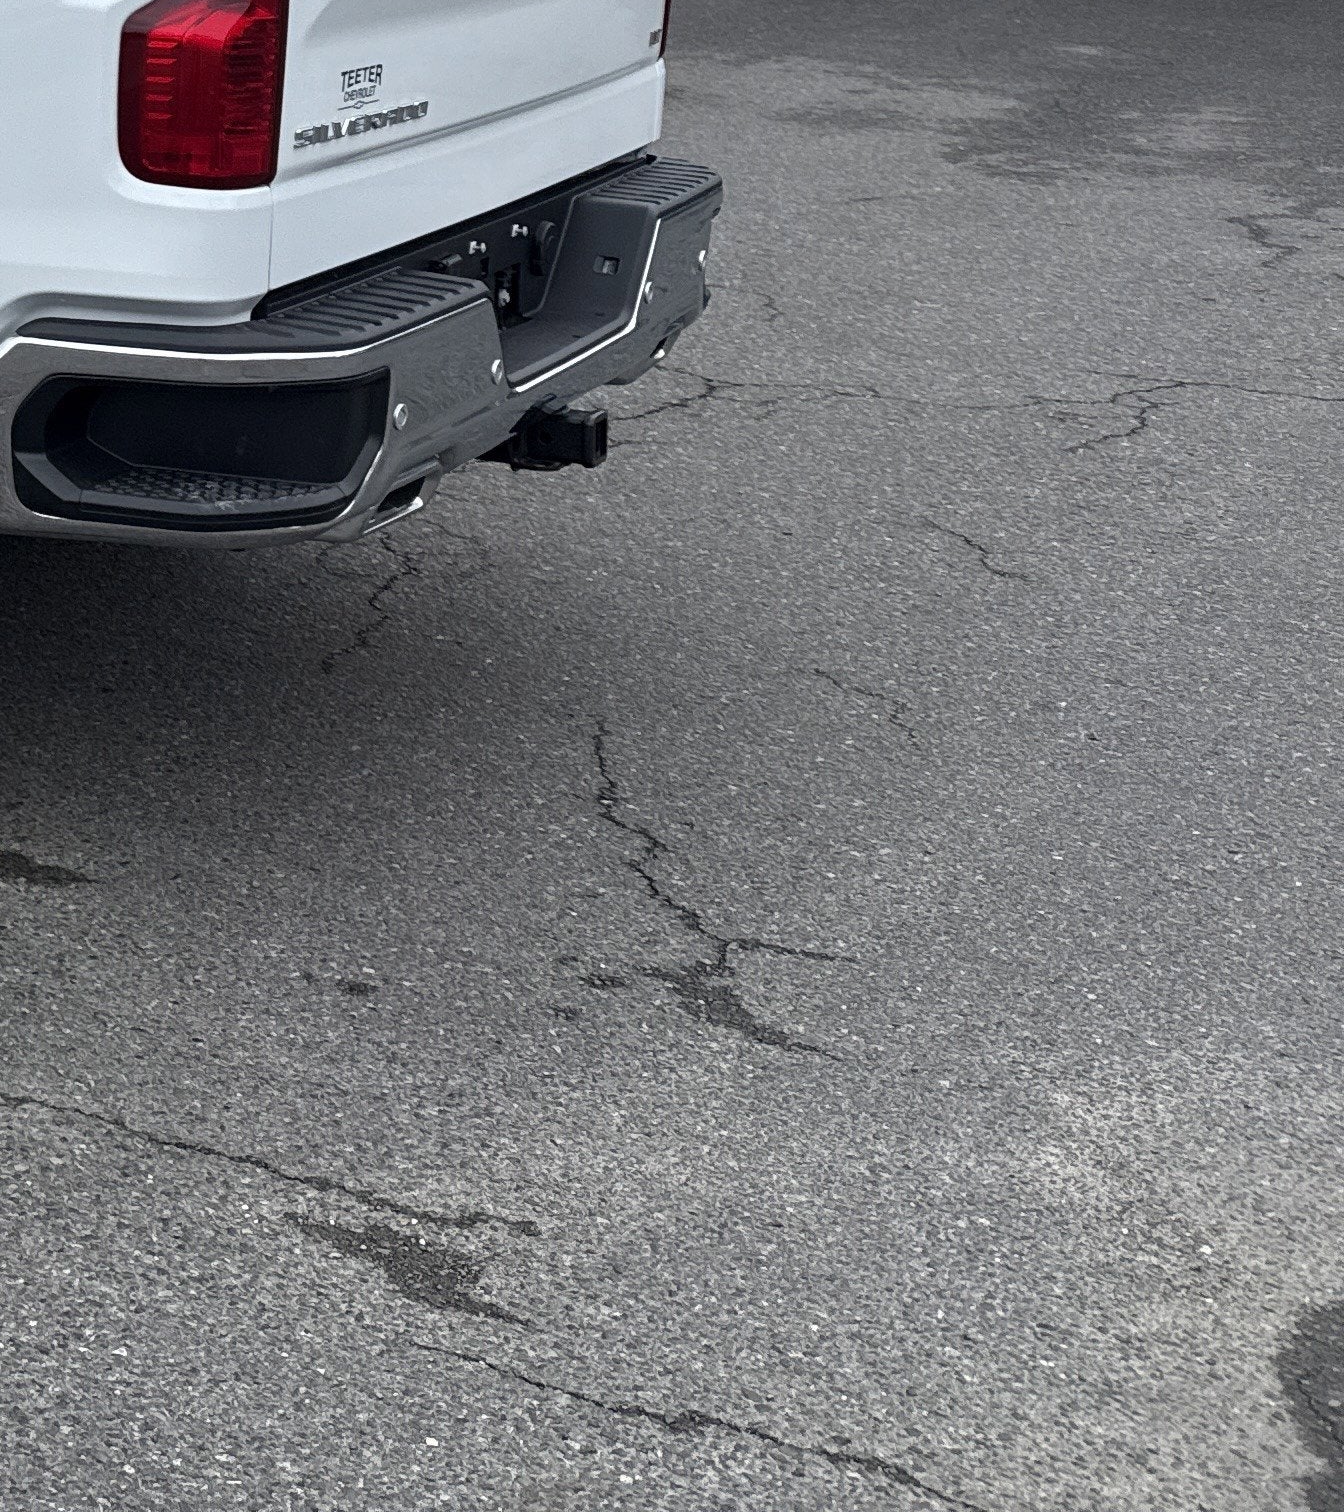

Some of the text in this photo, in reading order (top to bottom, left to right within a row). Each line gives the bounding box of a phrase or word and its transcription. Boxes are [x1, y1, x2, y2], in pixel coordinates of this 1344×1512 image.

[340, 64, 383, 93] TEETER
[343, 85, 377, 103] CHEVROLET
[293, 100, 429, 149] SILVERADO
